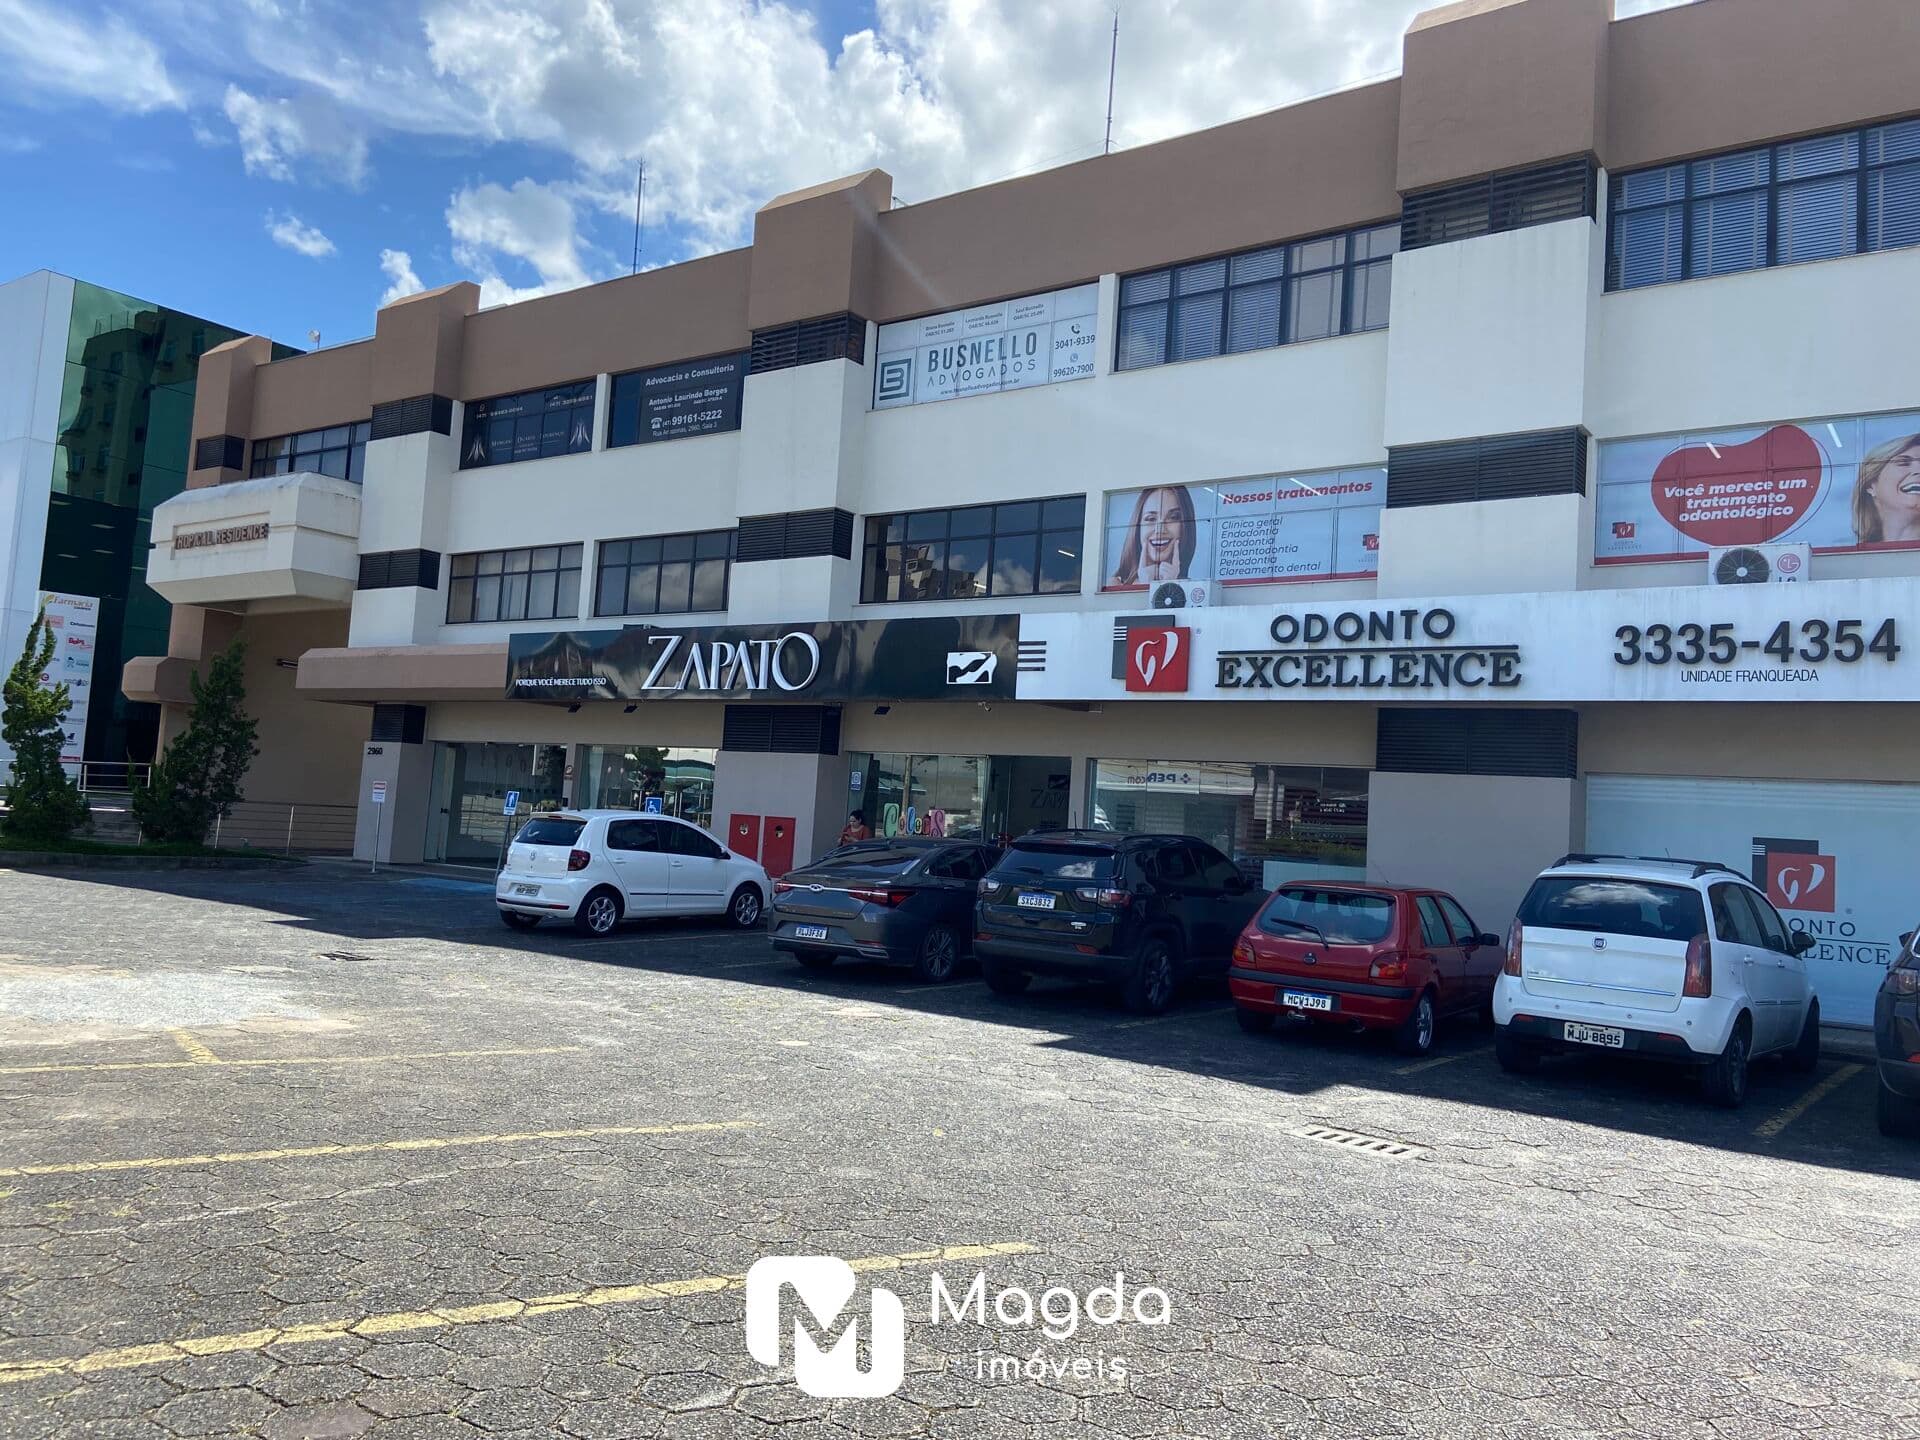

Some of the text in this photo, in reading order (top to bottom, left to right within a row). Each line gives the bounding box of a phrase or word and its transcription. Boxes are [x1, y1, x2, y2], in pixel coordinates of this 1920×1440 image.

[1055, 334, 1096, 350] 3041-9339
[927, 331, 1037, 373] BUSNELLO
[646, 372, 683, 386] Advocacia
[691, 363, 735, 378] Consultoria
[927, 359, 1036, 387] ADVOGADOS
[1053, 363, 1094, 378] 99620-7900
[648, 396, 673, 406] Antonio
[703, 387, 728, 397] Borges
[672, 409, 723, 426] 99161-5222
[1223, 481, 1372, 505] Nossos tratamentos
[1664, 478, 1807, 498] Você merece um
[1686, 492, 1787, 509] tratamento
[1256, 517, 1283, 529] geral
[1679, 504, 1794, 523] odontológico
[216, 523, 269, 545] RESIDENCE
[1221, 527, 1279, 539] Endodontia
[1220, 538, 1276, 548] Ortodontia
[1220, 545, 1299, 558] Implantodontia
[1219, 556, 1278, 567] Periodontia
[1219, 562, 1321, 576] Clareamento dental
[1269, 608, 1456, 644] ODONTO
[1613, 618, 1901, 665] 3335-4354
[641, 631, 820, 690] ZAPATO
[1215, 651, 1522, 688] EXCELLENCE
[515, 677, 607, 687] PORQUE VOCÊ MERECE TUDO ISSO
[1680, 669, 1819, 683] UNIDADE FRANQUEADA
[1788, 918, 1856, 937] ONTO
[1803, 943, 1891, 966] LENCE
